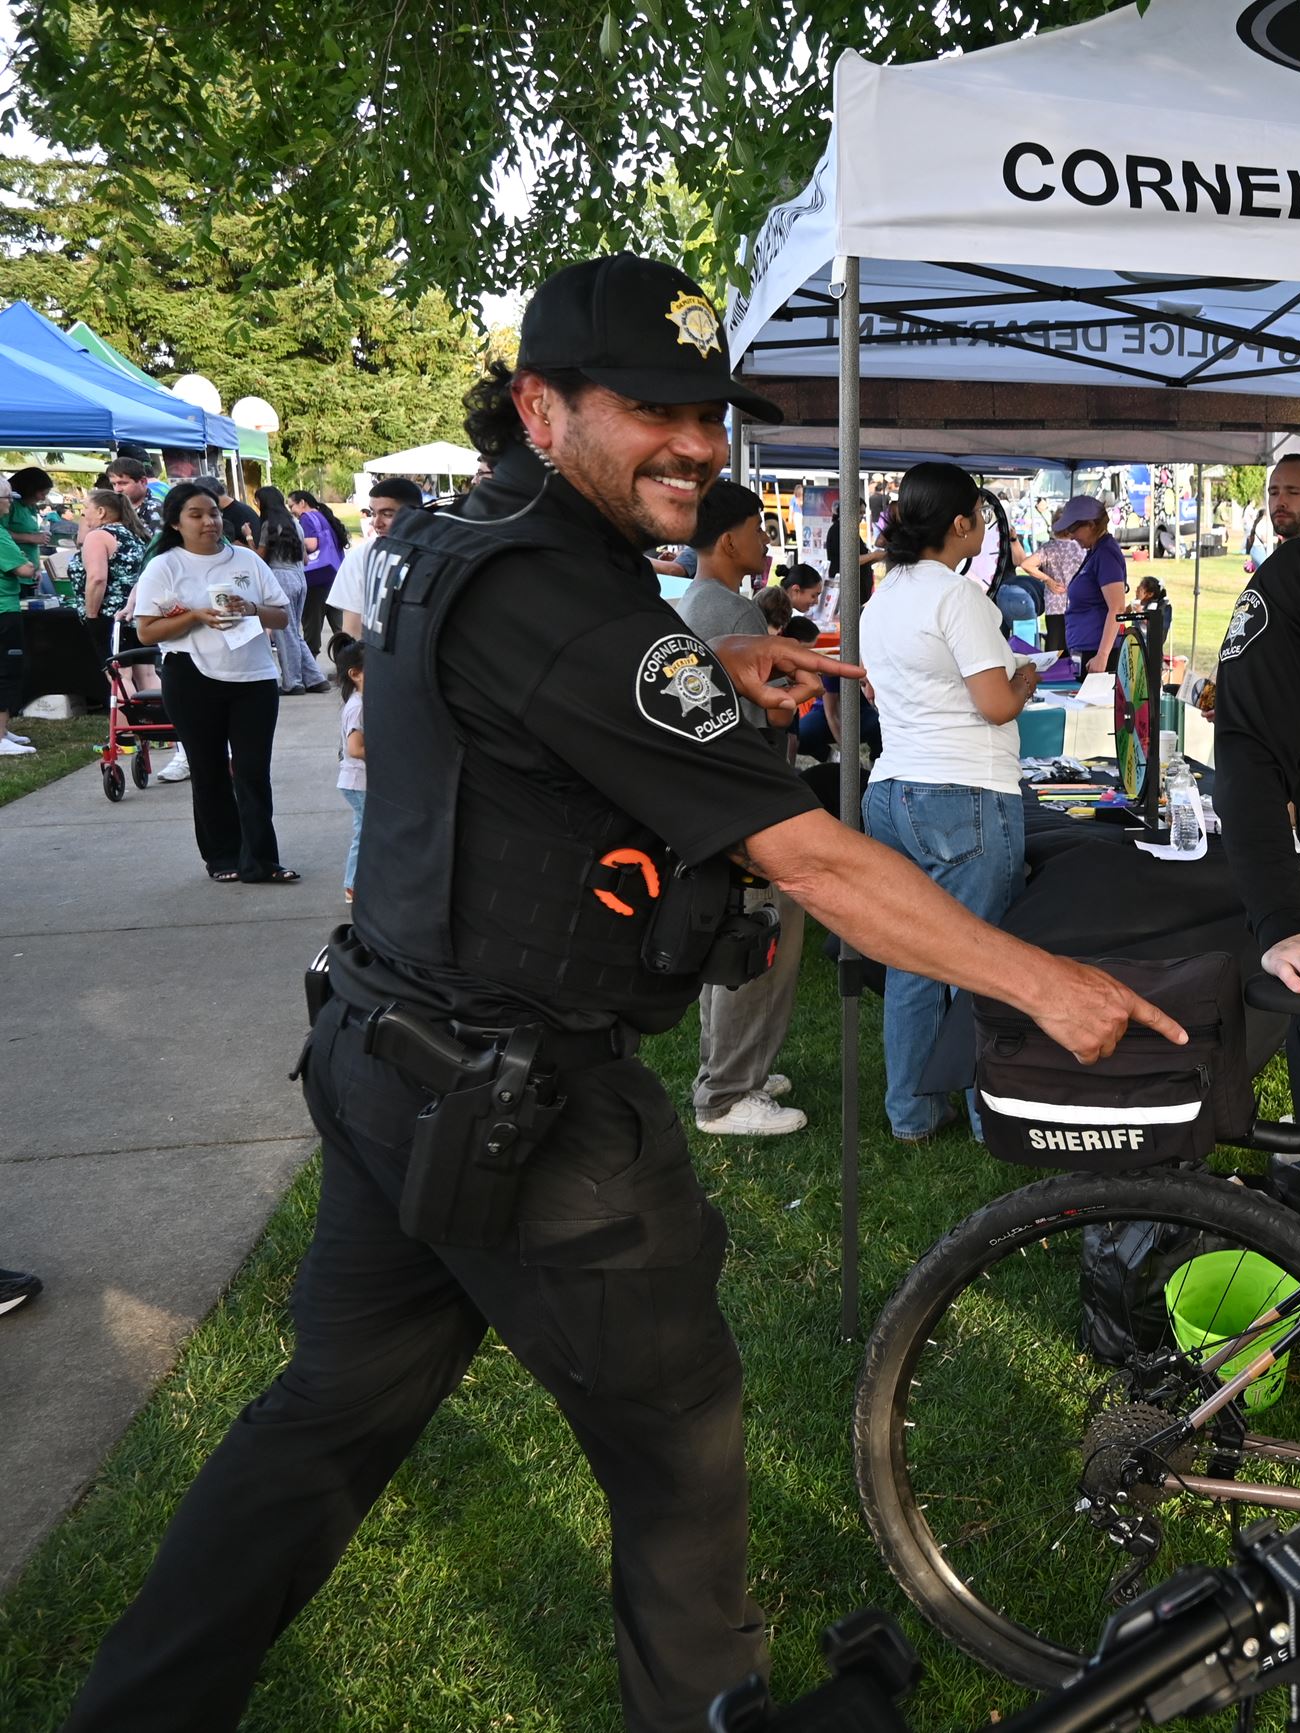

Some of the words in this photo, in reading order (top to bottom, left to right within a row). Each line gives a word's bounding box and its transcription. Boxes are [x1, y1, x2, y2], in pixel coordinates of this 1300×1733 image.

[643, 639, 706, 683] CORNELIUS
[1221, 644, 1241, 658] POLICE
[695, 708, 736, 738] POLICE
[1028, 1128, 1145, 1151] SHERIFF
